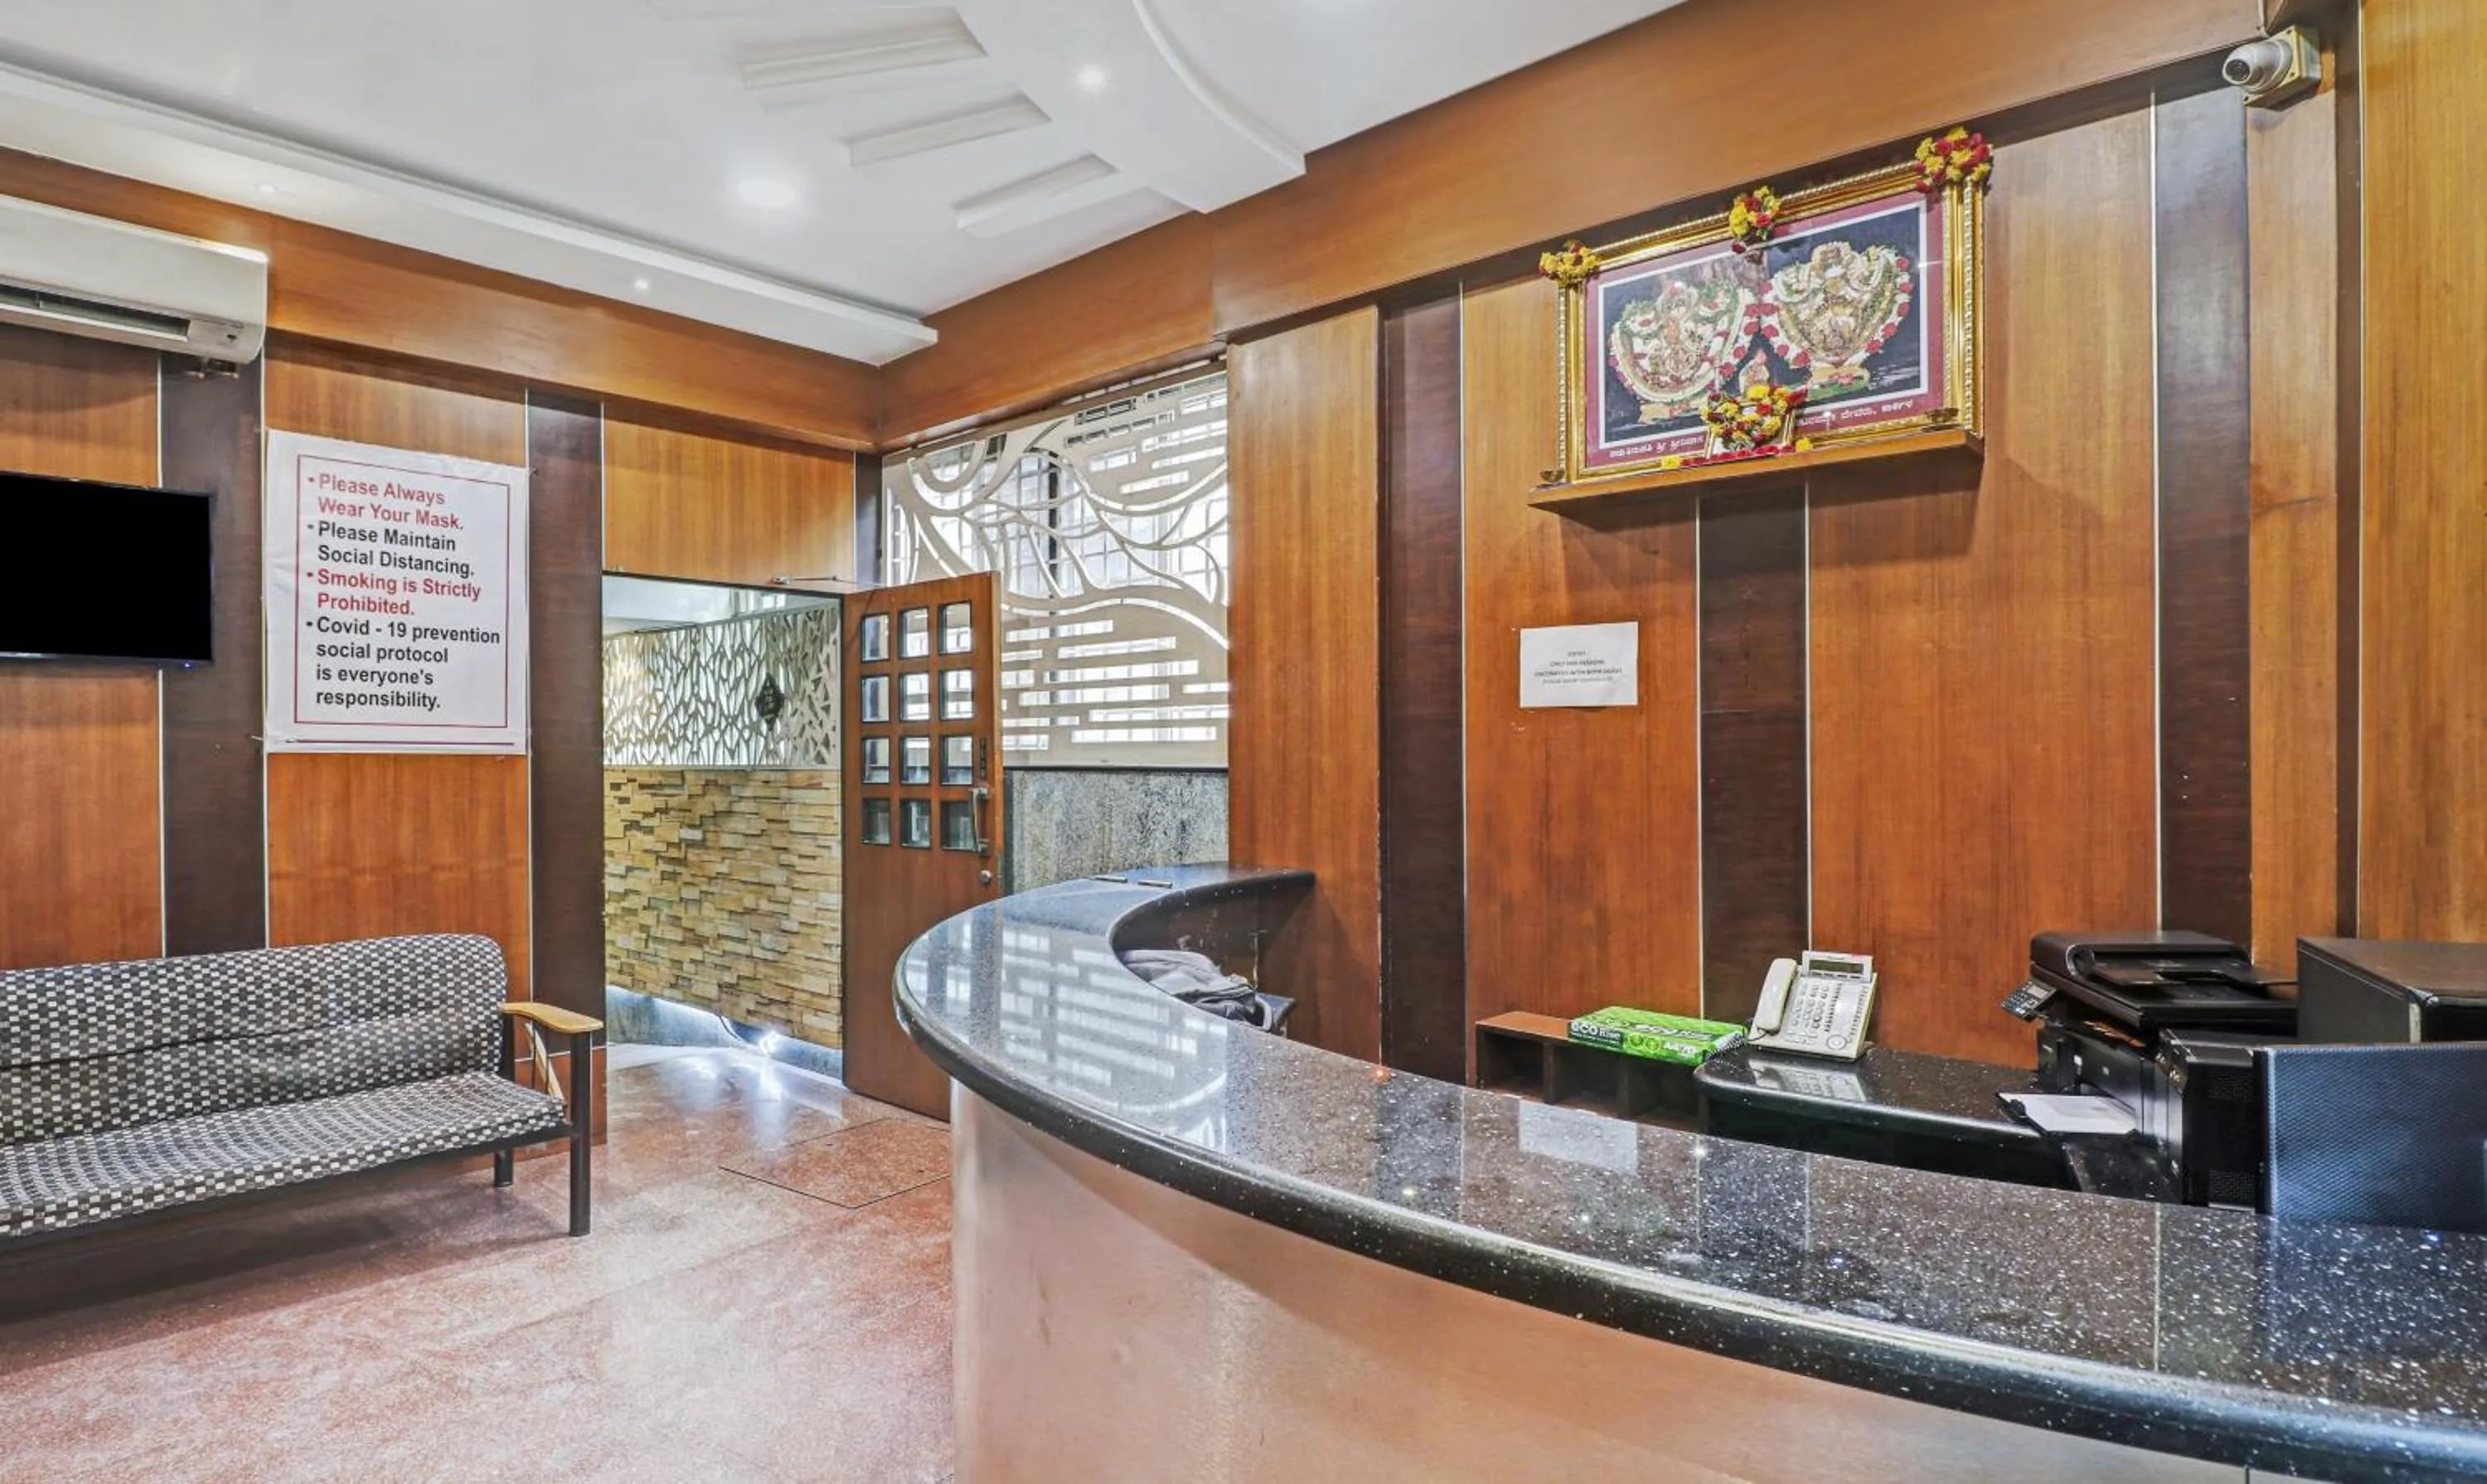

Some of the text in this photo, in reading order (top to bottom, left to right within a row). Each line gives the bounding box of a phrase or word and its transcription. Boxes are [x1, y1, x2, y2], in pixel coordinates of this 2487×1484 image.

[318, 473, 445, 507] Please Always
[318, 497, 463, 530] Wear Your Mask.
[318, 520, 455, 550] Please Maintain
[318, 545, 474, 579] Social Distancing.
[318, 569, 481, 602] Smoking is Strictly
[318, 593, 414, 615] Prohibited.
[317, 616, 370, 635] Covid
[388, 621, 406, 638] 19
[412, 625, 500, 644] prevention
[317, 642, 448, 663] social protocol
[317, 664, 434, 686] is everyone's
[317, 691, 440, 712] responsibility.
